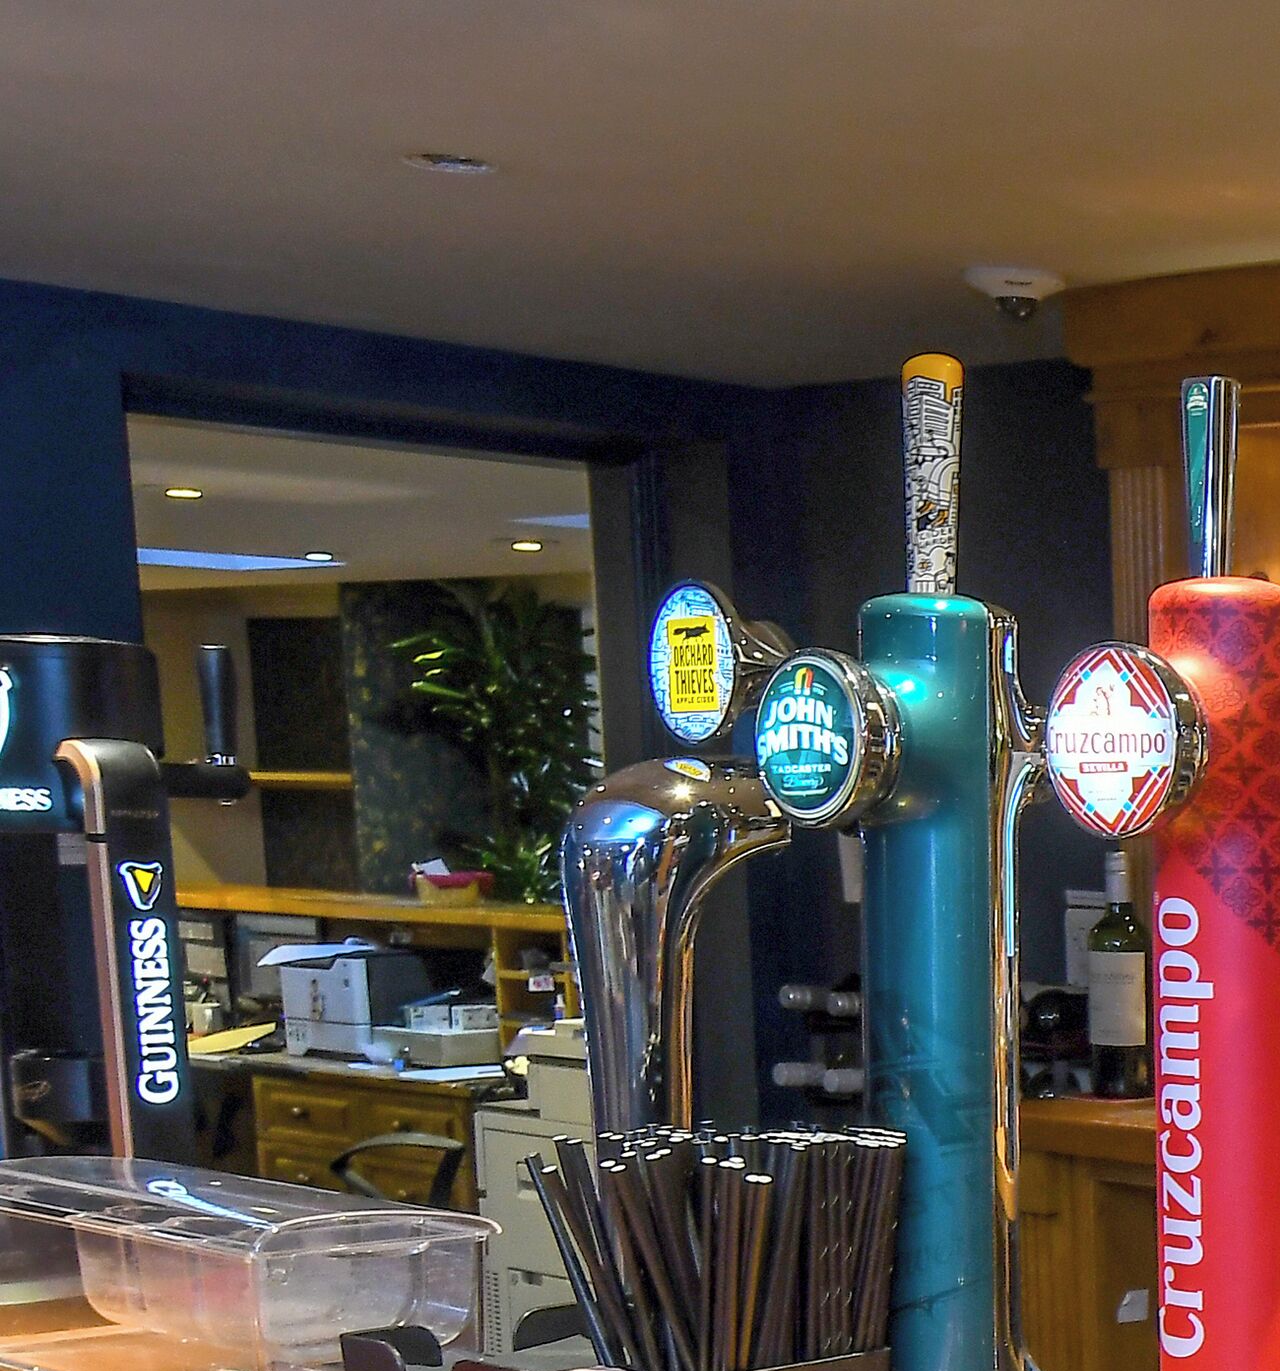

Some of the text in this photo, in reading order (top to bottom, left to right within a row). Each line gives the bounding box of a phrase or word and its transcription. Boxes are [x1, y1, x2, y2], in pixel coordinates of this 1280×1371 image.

[673, 643, 714, 668] ORCHARD
[674, 668, 715, 695] THIEVES
[676, 695, 715, 705] APPLE CIDER
[764, 695, 833, 730] JOHN
[757, 722, 850, 768] SMITH'S
[772, 763, 832, 775] TADCASTER
[131, 917, 179, 1104] GUINNESS
[1157, 895, 1215, 1360] Cruzcampo
